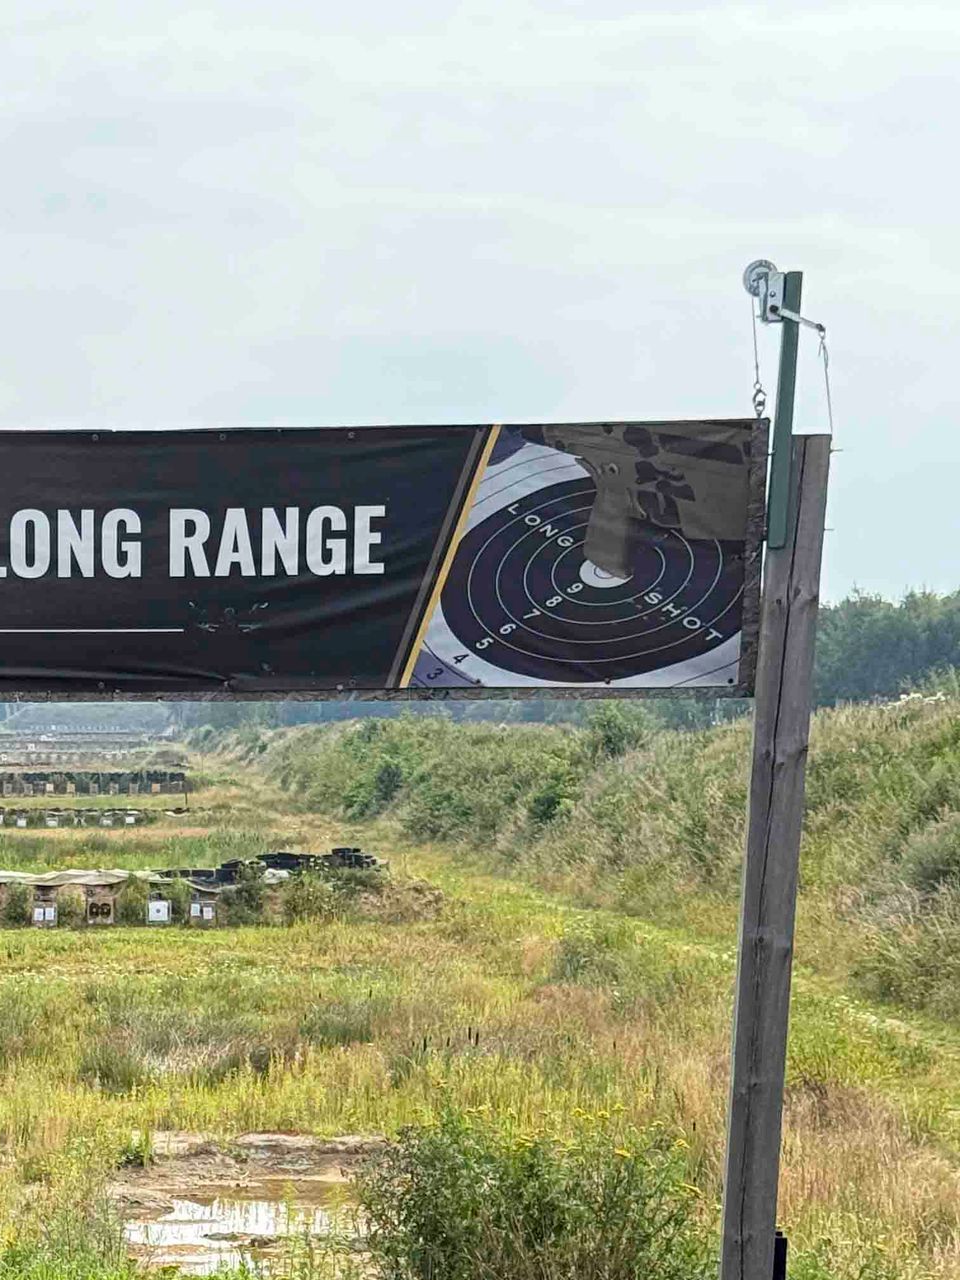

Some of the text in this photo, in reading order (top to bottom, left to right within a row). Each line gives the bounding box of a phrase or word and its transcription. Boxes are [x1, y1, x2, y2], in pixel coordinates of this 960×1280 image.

[168, 504, 386, 577] RANGE
[507, 503, 575, 548] LONG
[426, 582, 583, 680] 3 4 5 6 7 8 9
[644, 591, 724, 642] SHOT
